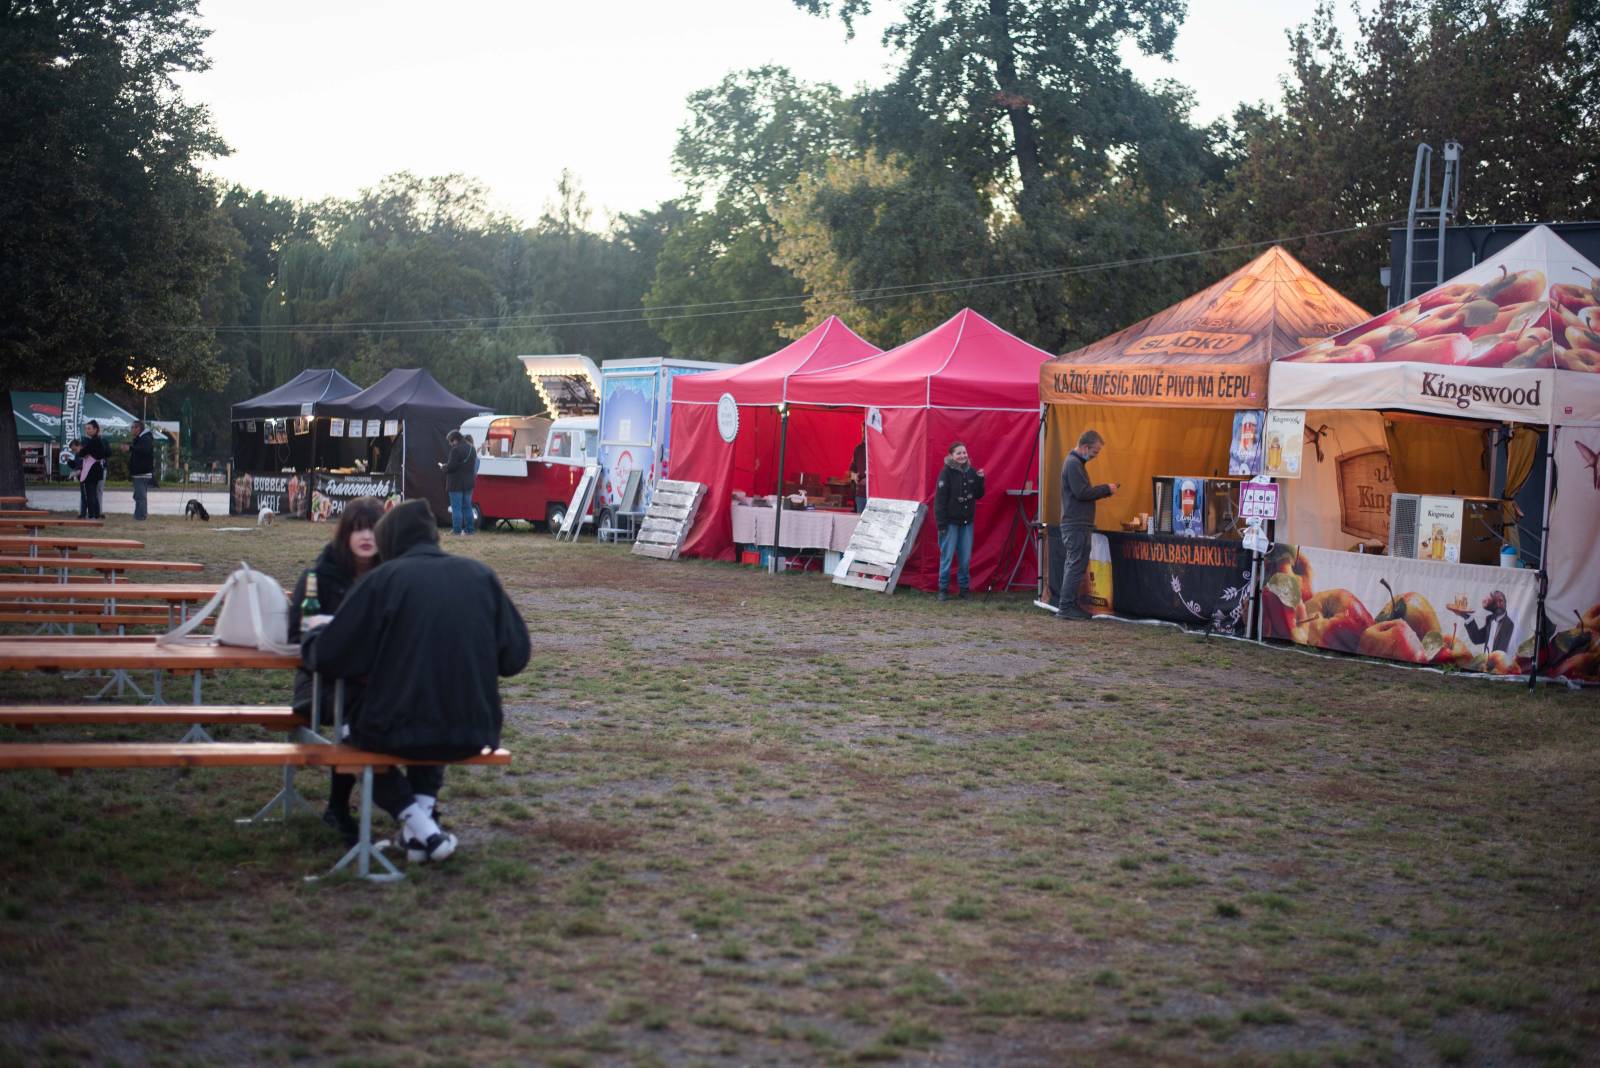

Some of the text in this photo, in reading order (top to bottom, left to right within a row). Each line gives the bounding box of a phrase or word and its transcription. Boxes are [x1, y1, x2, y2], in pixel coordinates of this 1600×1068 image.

[1053, 370, 1250, 398] KAŽDÝ MĚSÍC NOVÉ PIVO NA ČEPU
[1421, 371, 1541, 409] Kingswood
[59, 376, 81, 465] Plsner Urquell
[254, 477, 287, 492] BUBBLE
